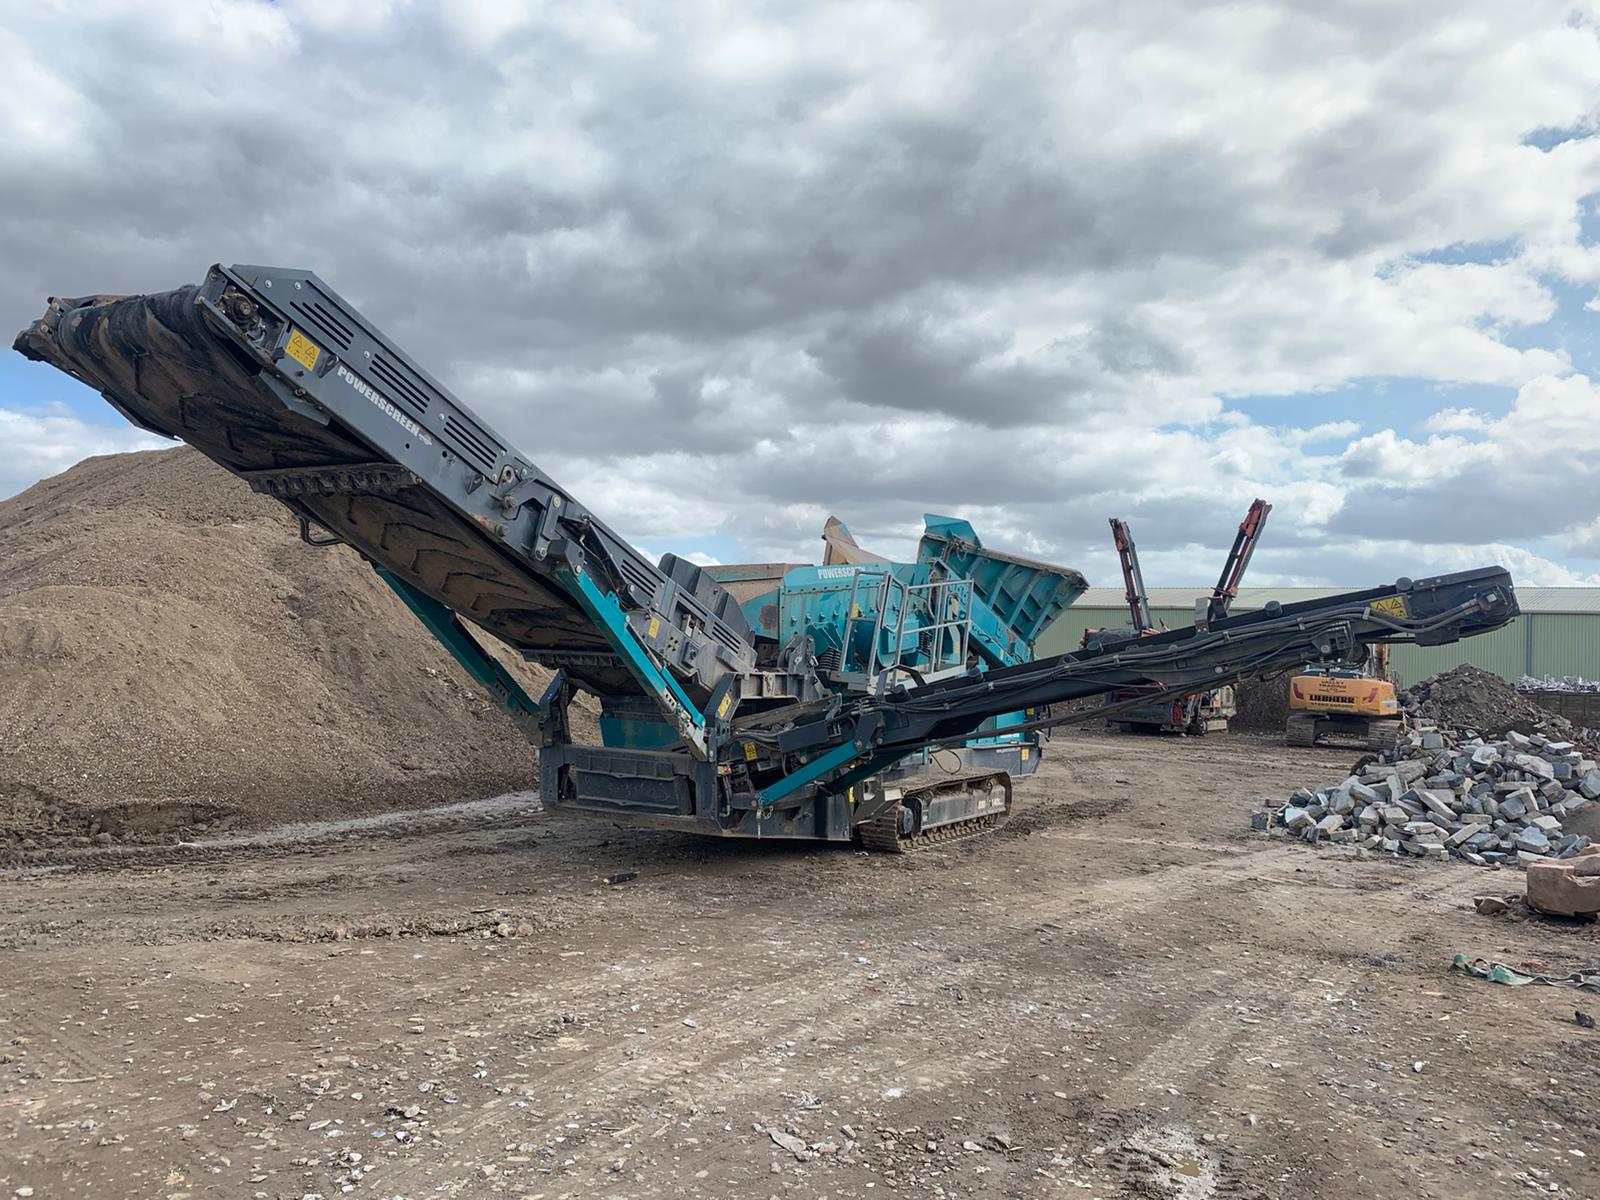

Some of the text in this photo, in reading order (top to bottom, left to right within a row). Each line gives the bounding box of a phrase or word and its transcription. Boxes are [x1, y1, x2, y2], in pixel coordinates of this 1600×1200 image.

[337, 365, 420, 437] POWERSCREEN
[817, 566, 866, 580] POWERSCRN
[1310, 694, 1354, 703] LIEBHERR
